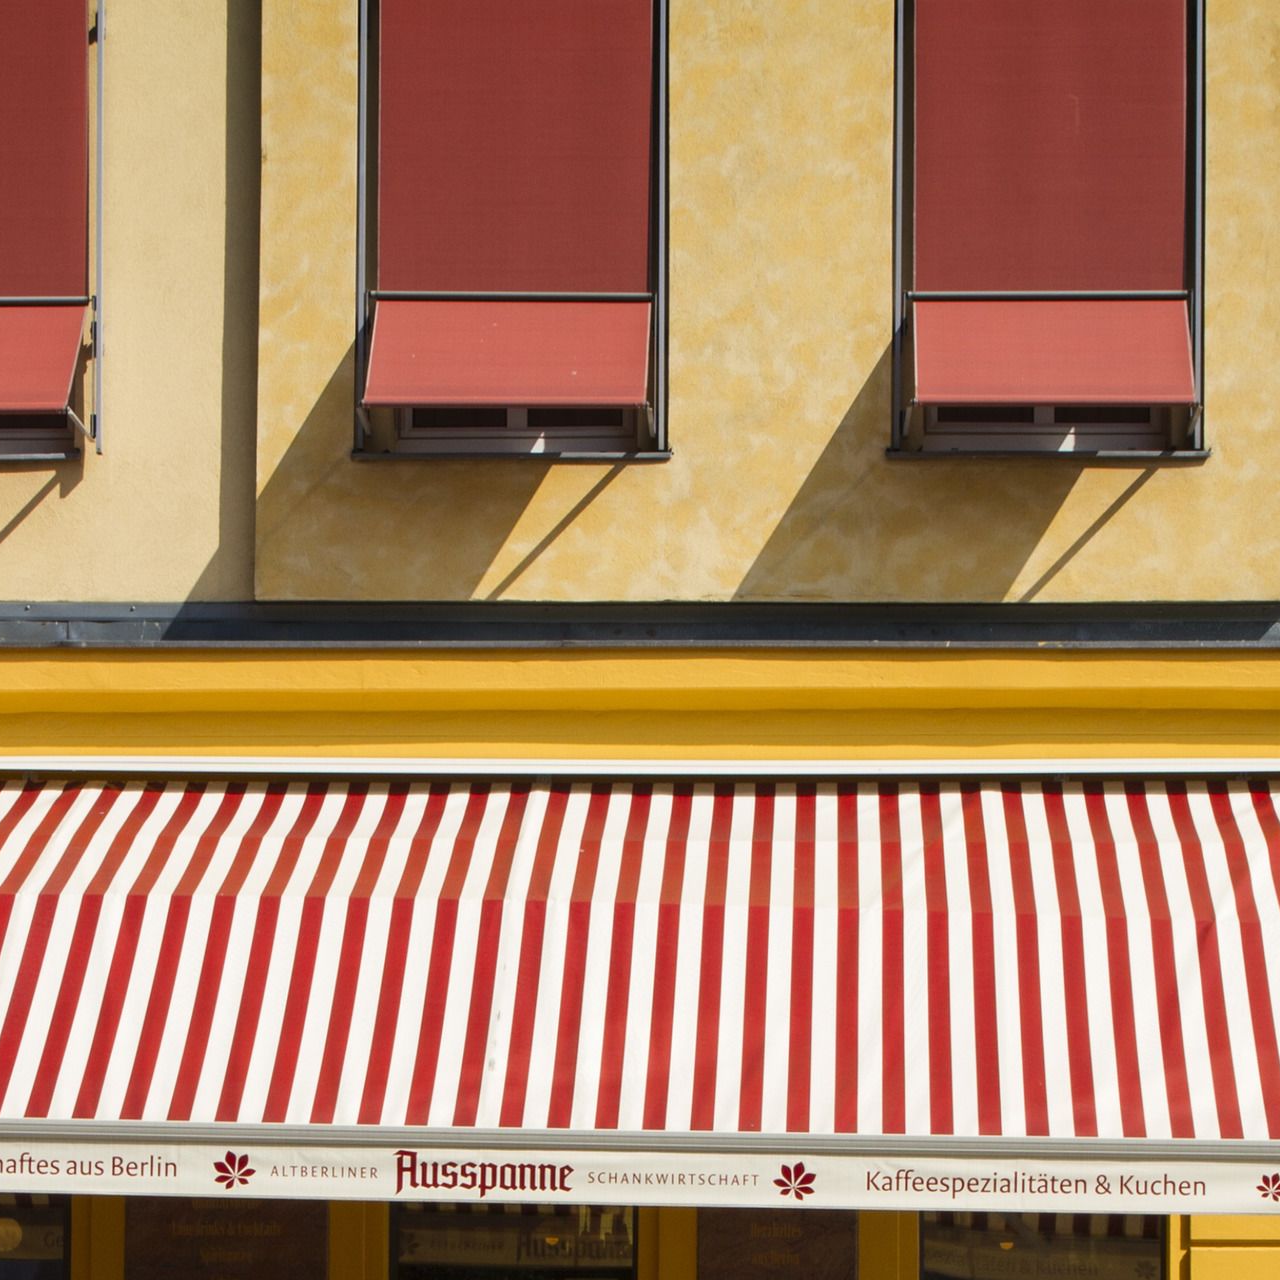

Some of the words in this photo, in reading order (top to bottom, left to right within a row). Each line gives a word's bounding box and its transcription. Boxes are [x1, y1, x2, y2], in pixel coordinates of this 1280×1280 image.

[65, 1159, 105, 1176] aus
[111, 1154, 178, 1178] Berlin
[270, 1164, 379, 1179] ALTBERLINER
[392, 1149, 575, 1199] Ausspanne
[587, 1171, 760, 1187] SCHANKWIRTSCHAFT
[865, 1168, 1088, 1199] Kaffeespezialitäten
[1094, 1174, 1113, 1196] &
[1119, 1173, 1207, 1197] Kuchen
